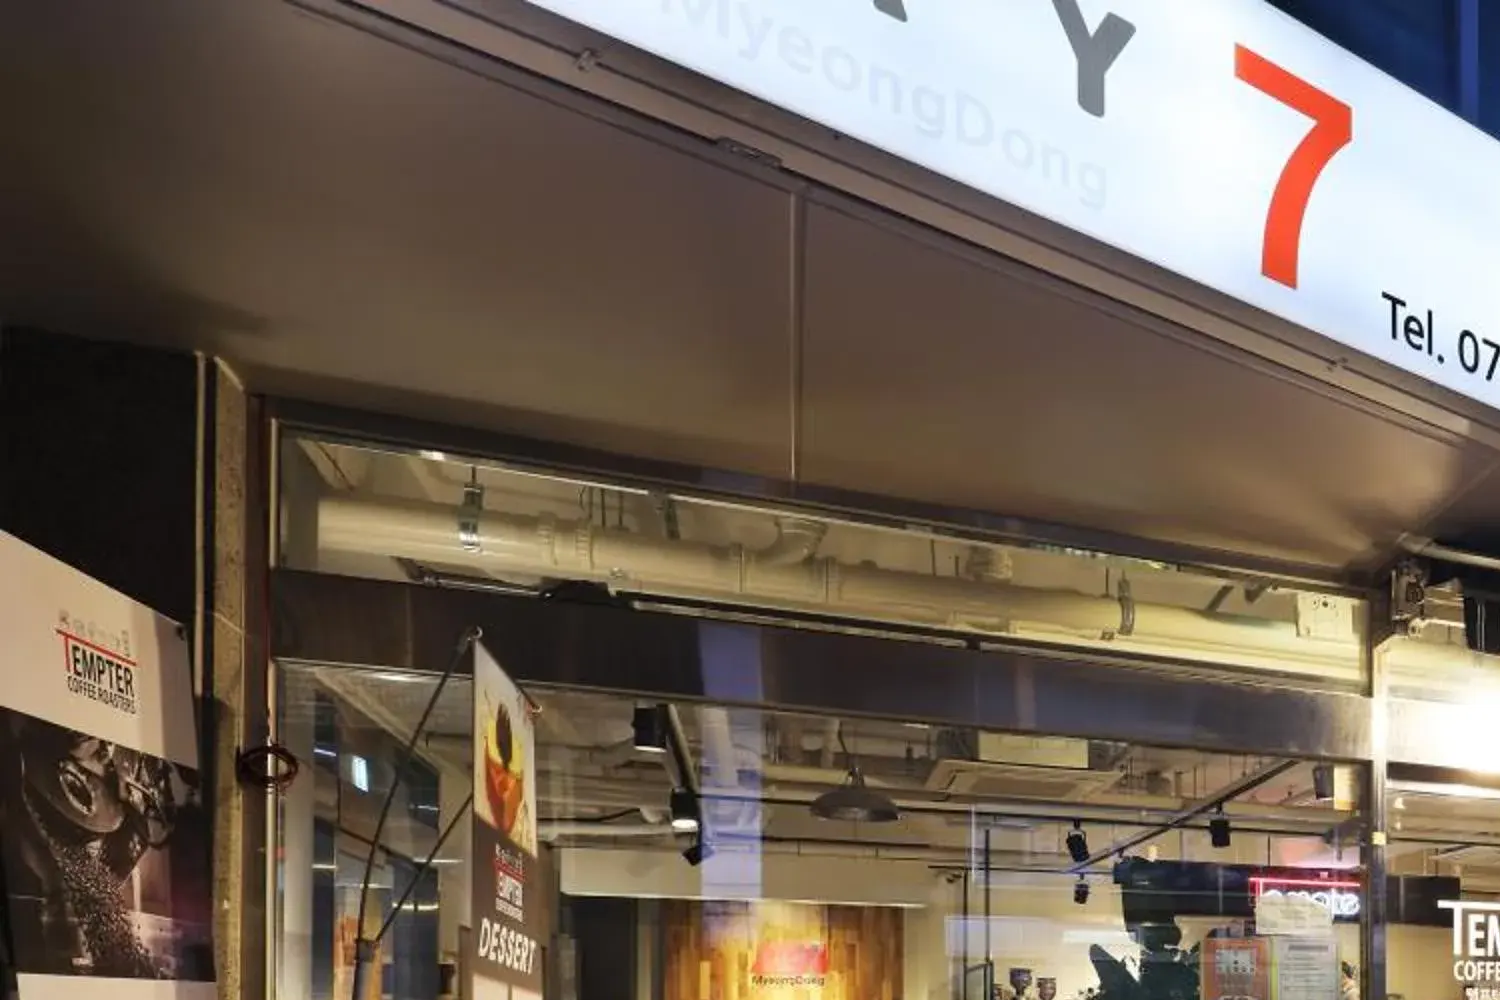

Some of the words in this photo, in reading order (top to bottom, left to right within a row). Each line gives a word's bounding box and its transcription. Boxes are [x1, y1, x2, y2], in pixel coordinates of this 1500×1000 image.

[1234, 42, 1353, 291] 7
[1381, 291, 1445, 364] Tel.
[56, 628, 138, 698] TEMPTER
[67, 675, 97, 701] COFFEE
[478, 917, 537, 975] DESSERT
